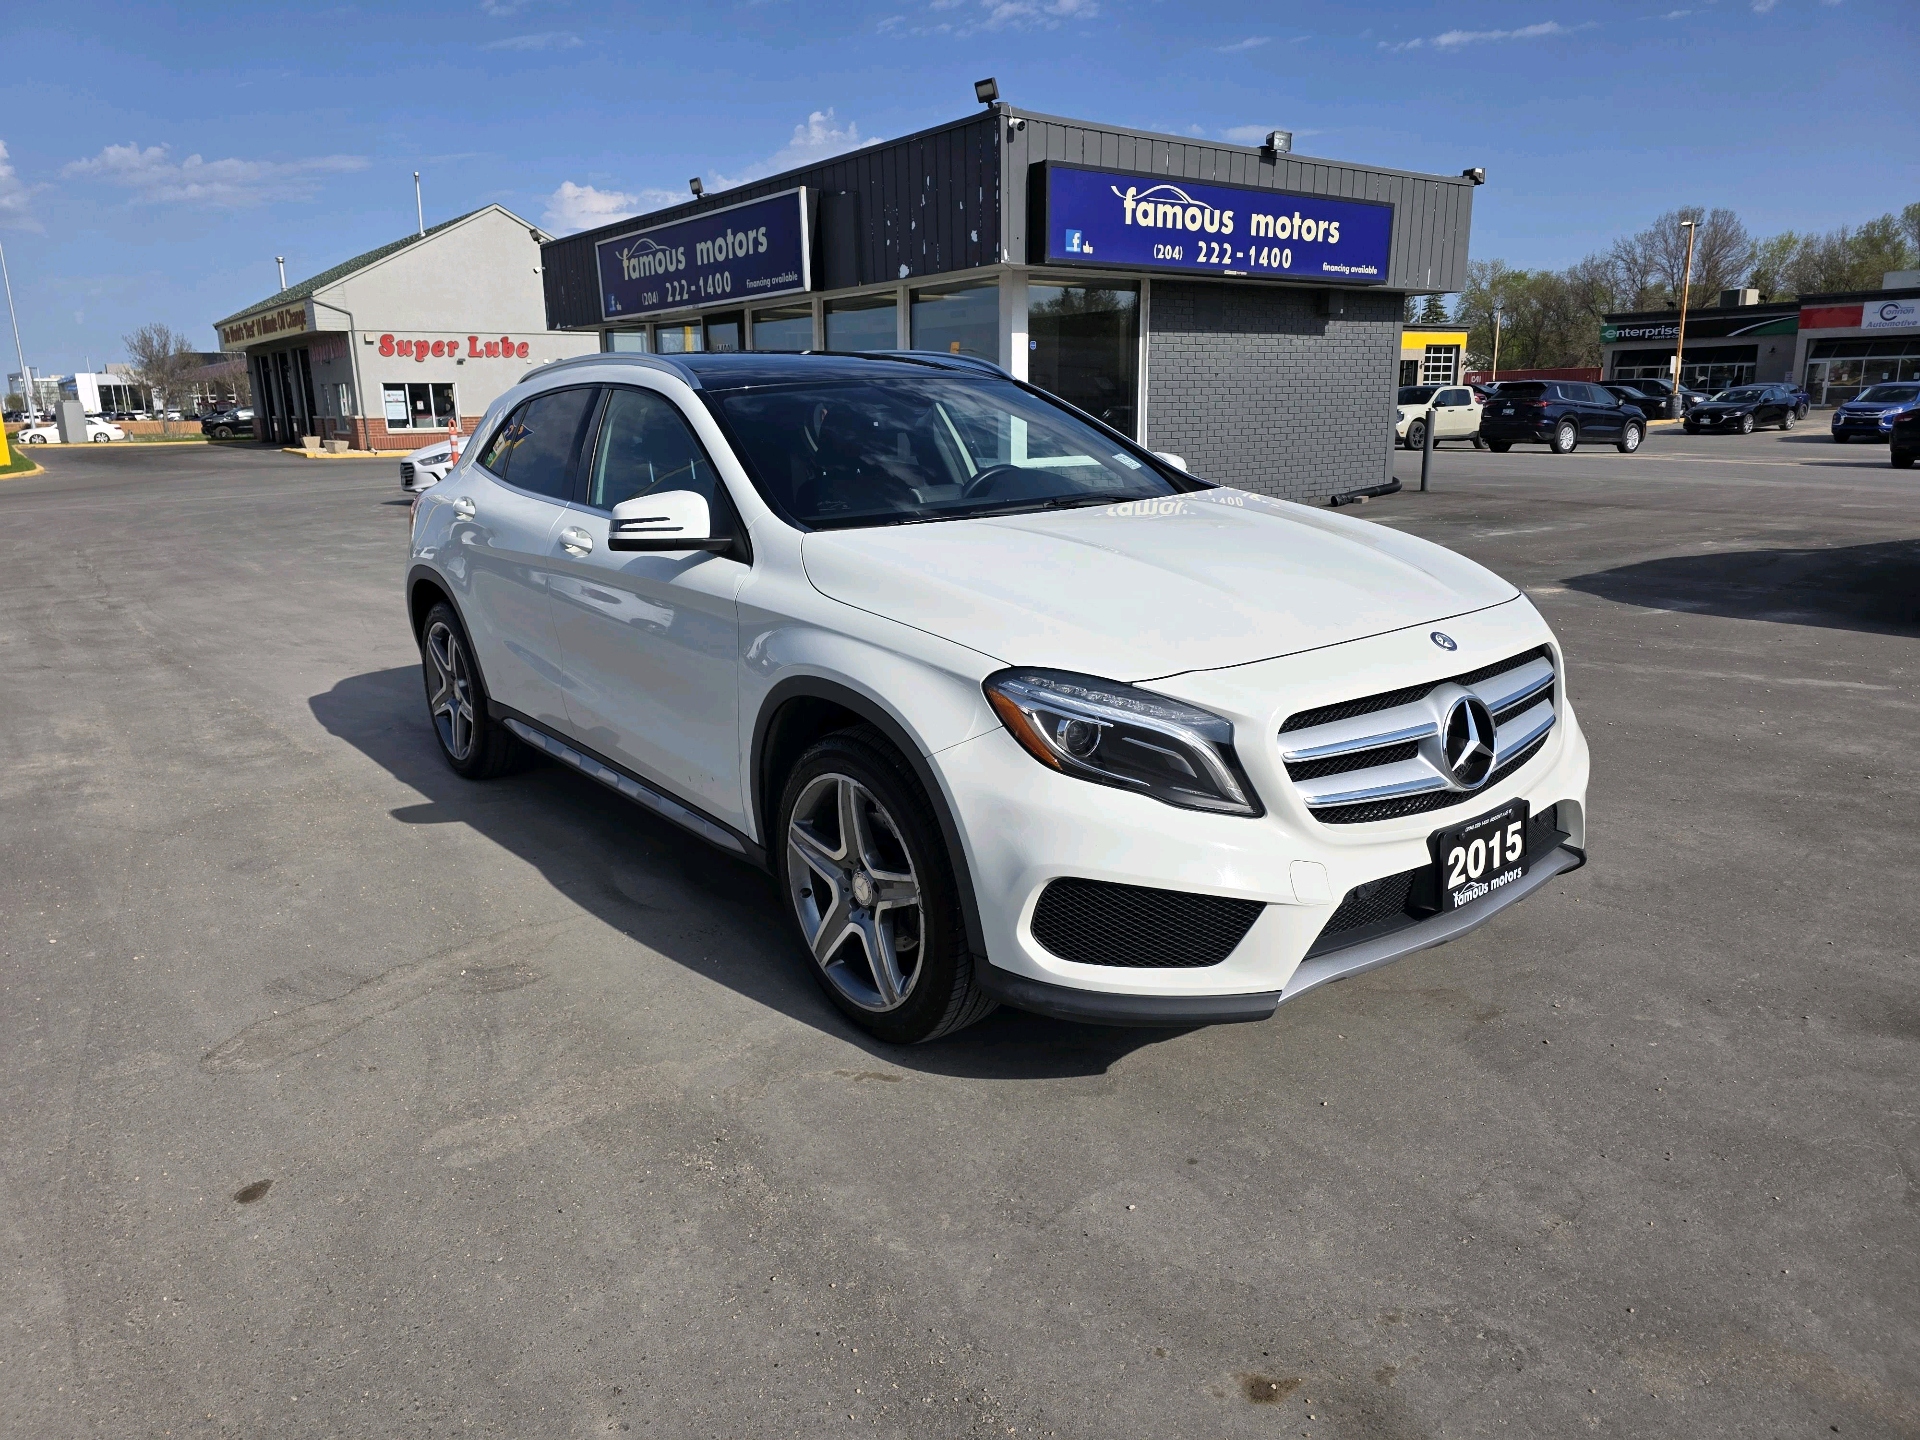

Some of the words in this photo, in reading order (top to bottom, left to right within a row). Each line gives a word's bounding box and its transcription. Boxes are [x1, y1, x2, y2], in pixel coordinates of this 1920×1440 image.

[1124, 186, 1234, 235] famous
[1250, 211, 1340, 244] motors
[622, 246, 686, 281] famous
[696, 226, 768, 266] motors
[1153, 243, 1183, 260] (204)
[1322, 262, 1350, 275] financing
[1350, 264, 1378, 275] available
[746, 276, 771, 289] financing
[771, 270, 798, 285] available
[641, 291, 659, 306] (204)
[277, 310, 286, 331] Oil
[285, 308, 307, 331] Change
[1866, 320, 1918, 328] Automotive
[1601, 325, 1681, 339] enterprise
[378, 334, 459, 362] Super
[467, 336, 529, 358] Lube
[1447, 820, 1523, 890] 2015
[1453, 881, 1489, 908] famous
[1490, 866, 1522, 891] motors
